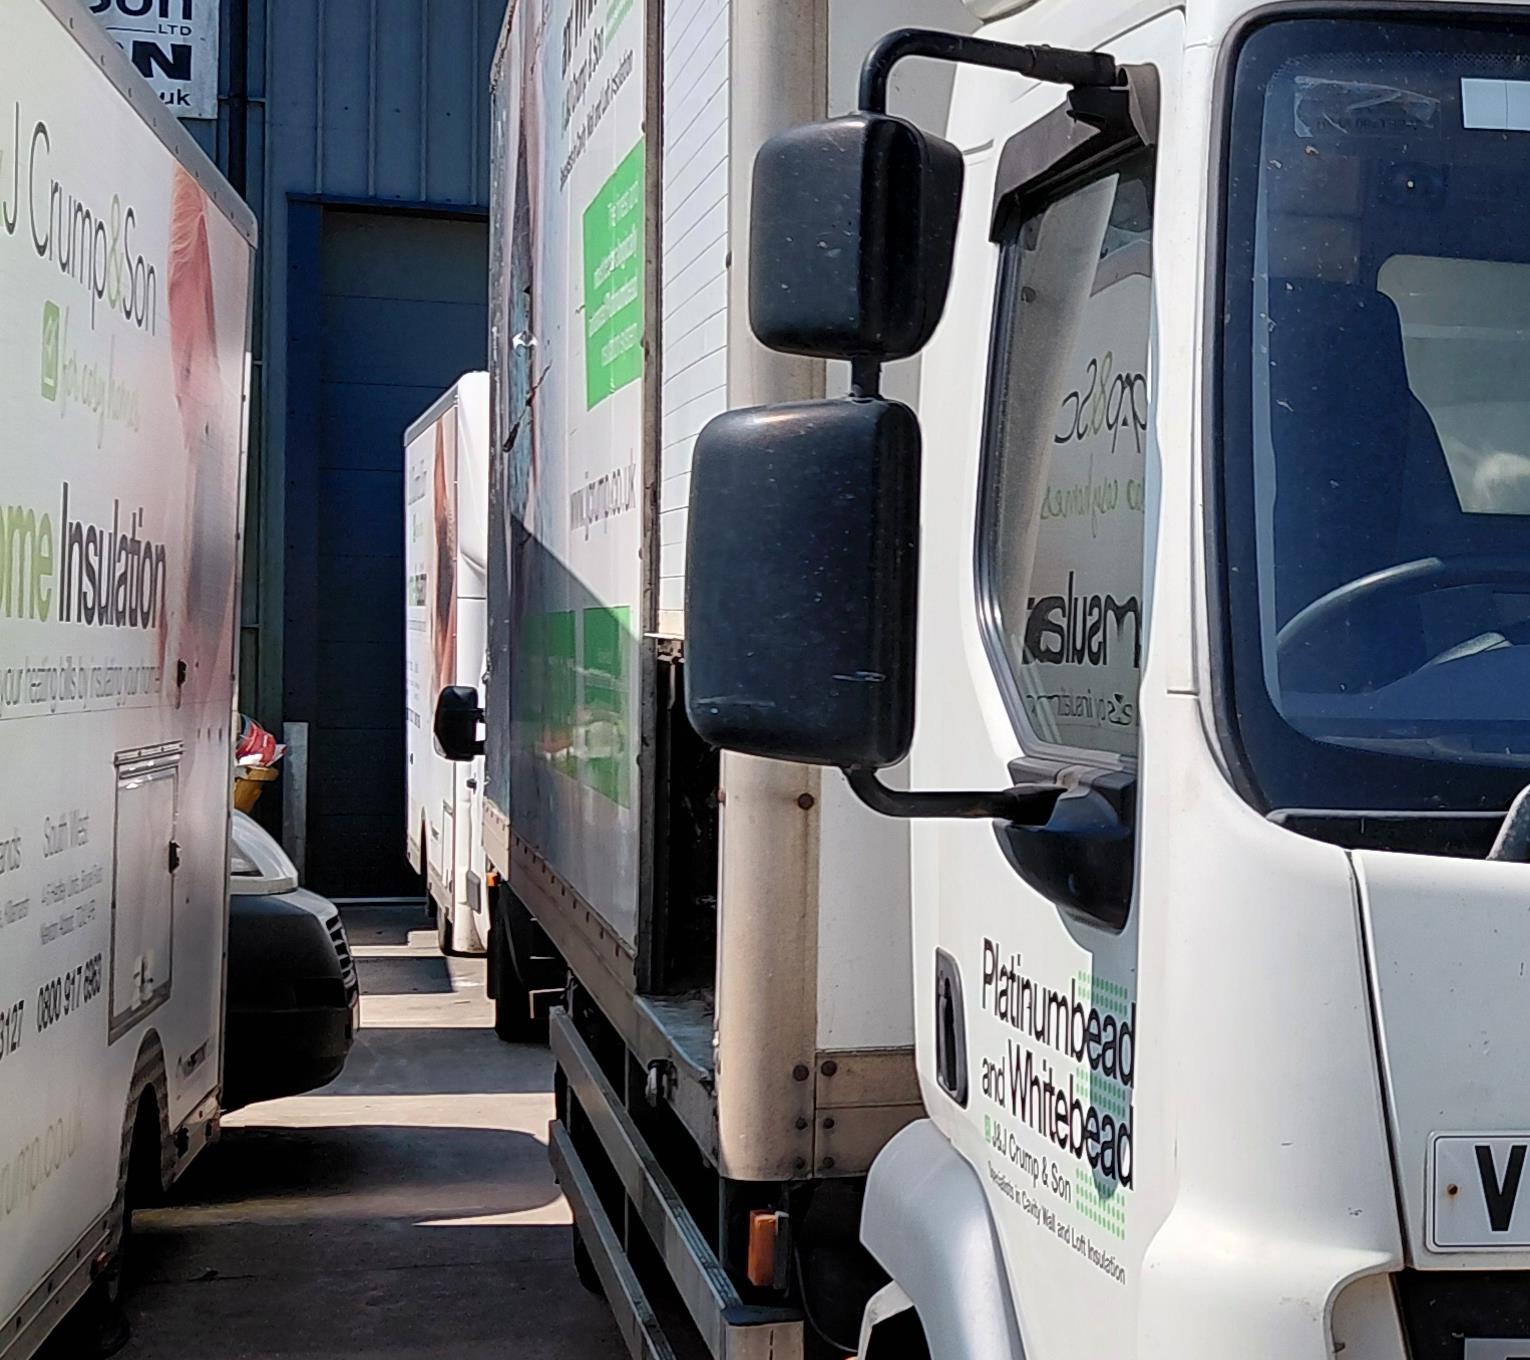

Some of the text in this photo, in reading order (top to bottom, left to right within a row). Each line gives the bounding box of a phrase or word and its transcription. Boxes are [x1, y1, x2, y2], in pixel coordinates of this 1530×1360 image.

[158, 24, 192, 36] LTD
[59, 481, 166, 629] Insulation
[982, 937, 1136, 1089] Platinumbead
[982, 1038, 1135, 1192] and Whitebead
[1009, 1132, 1039, 1189] Crump
[1051, 1162, 1072, 1204] Son
